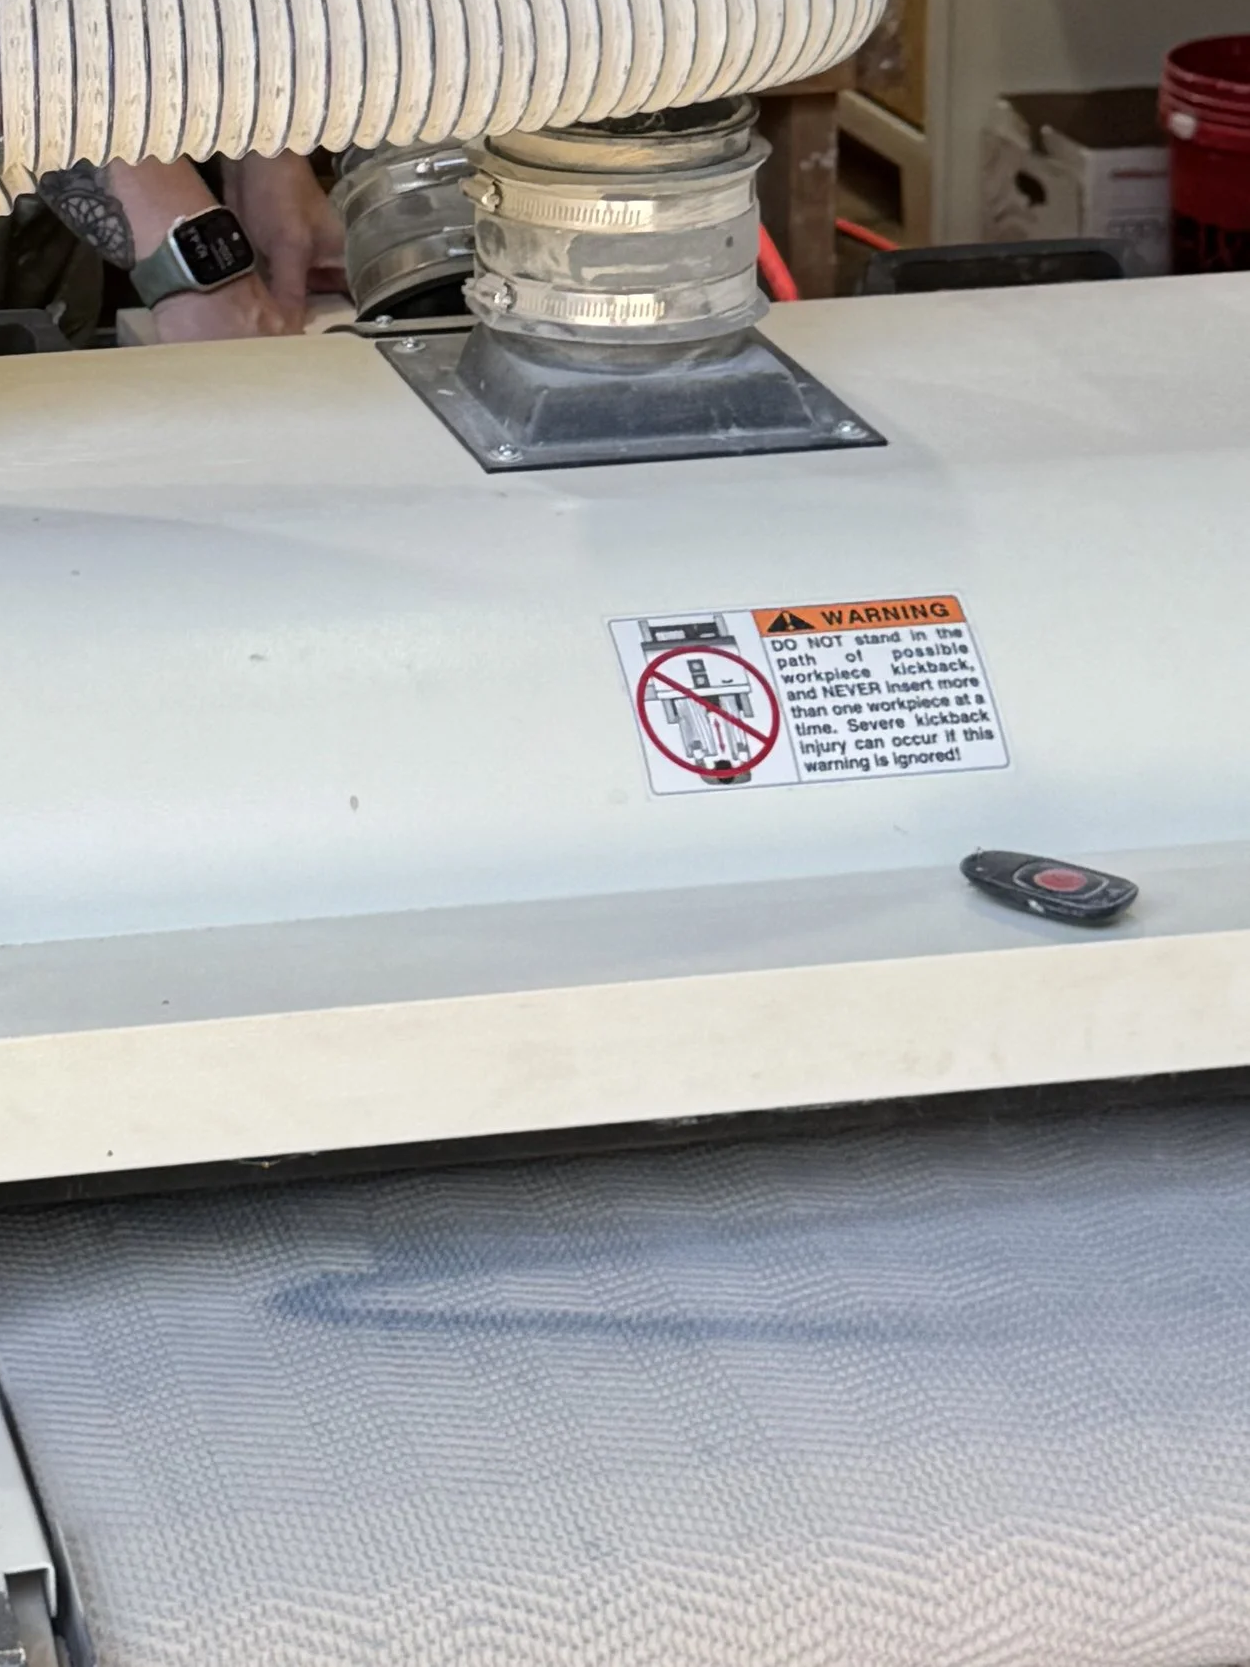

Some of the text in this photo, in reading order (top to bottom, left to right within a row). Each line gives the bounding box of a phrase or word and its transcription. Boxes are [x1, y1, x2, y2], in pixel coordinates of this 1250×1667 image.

[820, 602, 950, 626] WARNING
[771, 627, 963, 652] DO NOT stand in the
[777, 642, 969, 670] path of possible
[781, 657, 975, 684] workpiece kickback,
[787, 676, 979, 701] and NEVER insert more
[791, 693, 985, 719] than one workpiece at a
[795, 709, 991, 736] time. Severe kickback
[800, 727, 994, 757] injury can occur if this
[804, 747, 961, 773] warning is ignored!
